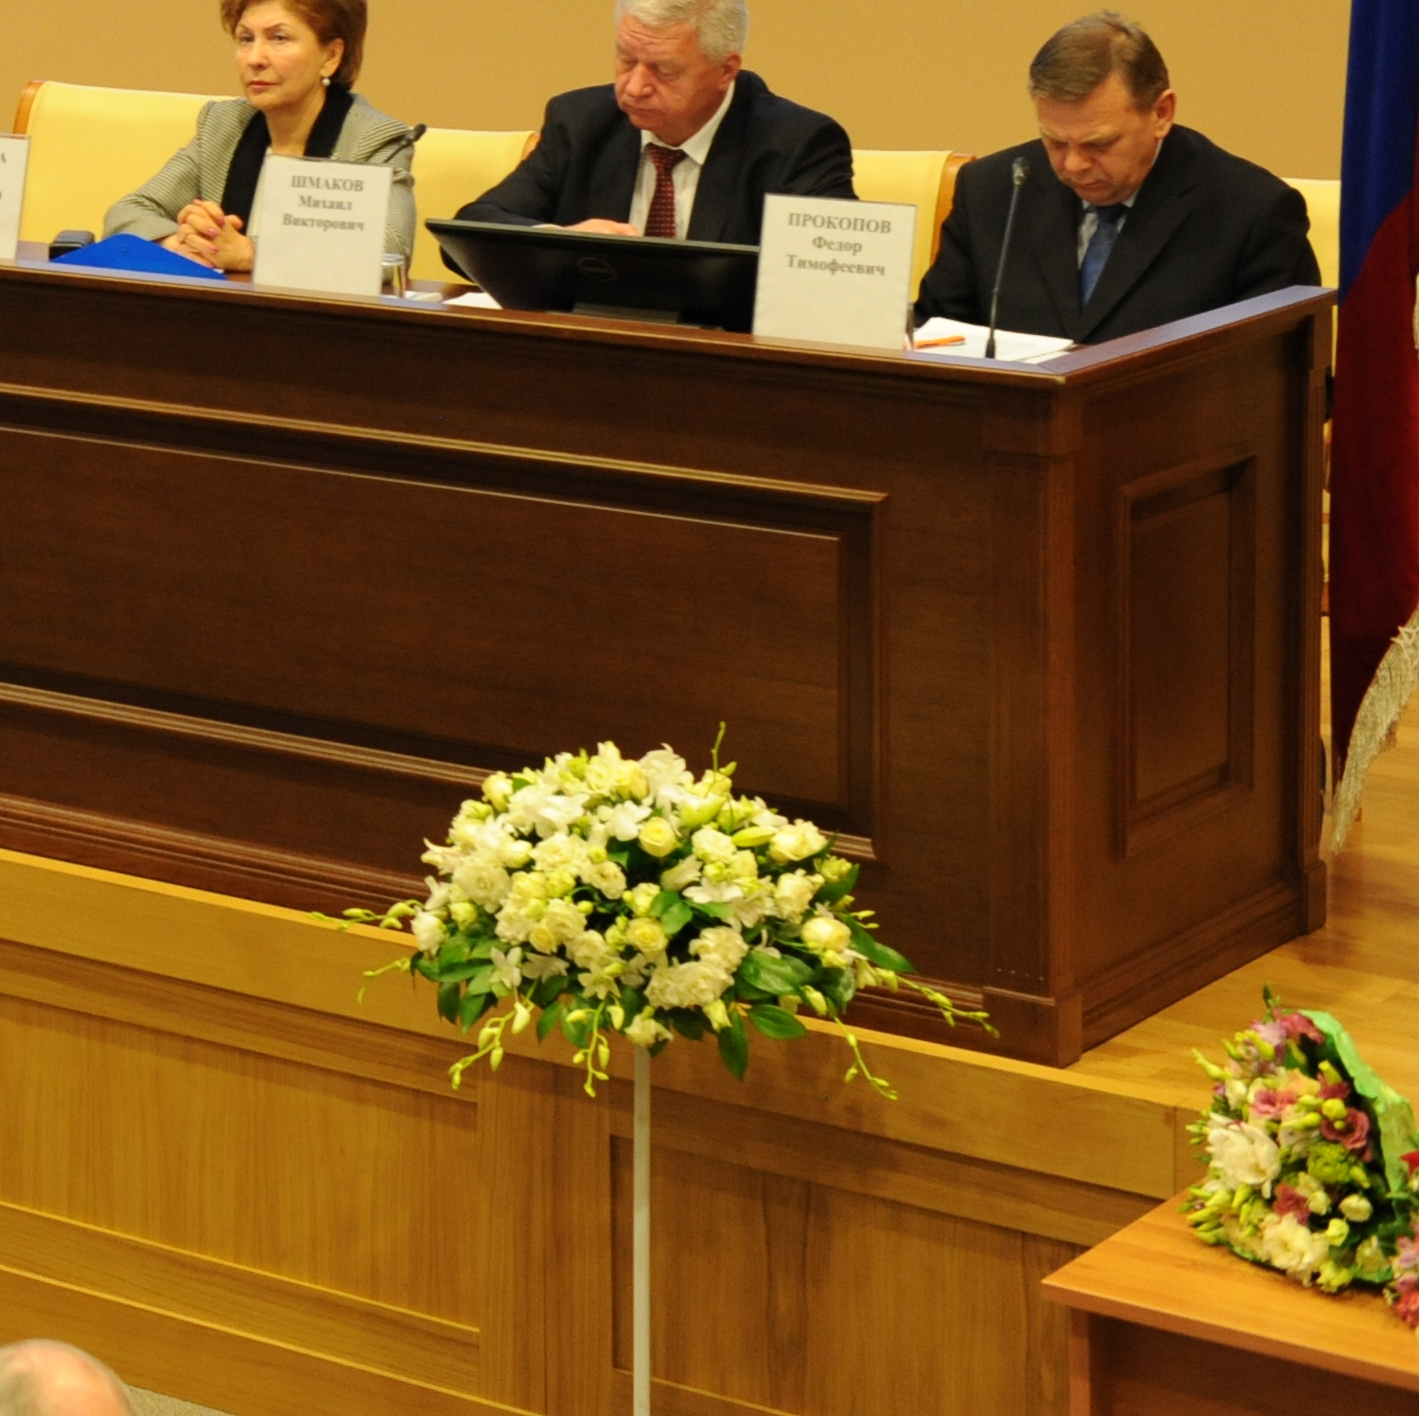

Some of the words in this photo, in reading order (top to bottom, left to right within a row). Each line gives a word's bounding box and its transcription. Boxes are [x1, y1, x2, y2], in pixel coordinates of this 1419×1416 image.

[290, 175, 365, 193] ШМАКОВ
[297, 194, 353, 211] Михаил
[282, 212, 365, 232] Викторович
[788, 211, 892, 234] ПРОКОПОВ
[811, 235, 863, 256] Федор
[785, 253, 886, 276] Тимофеевич
